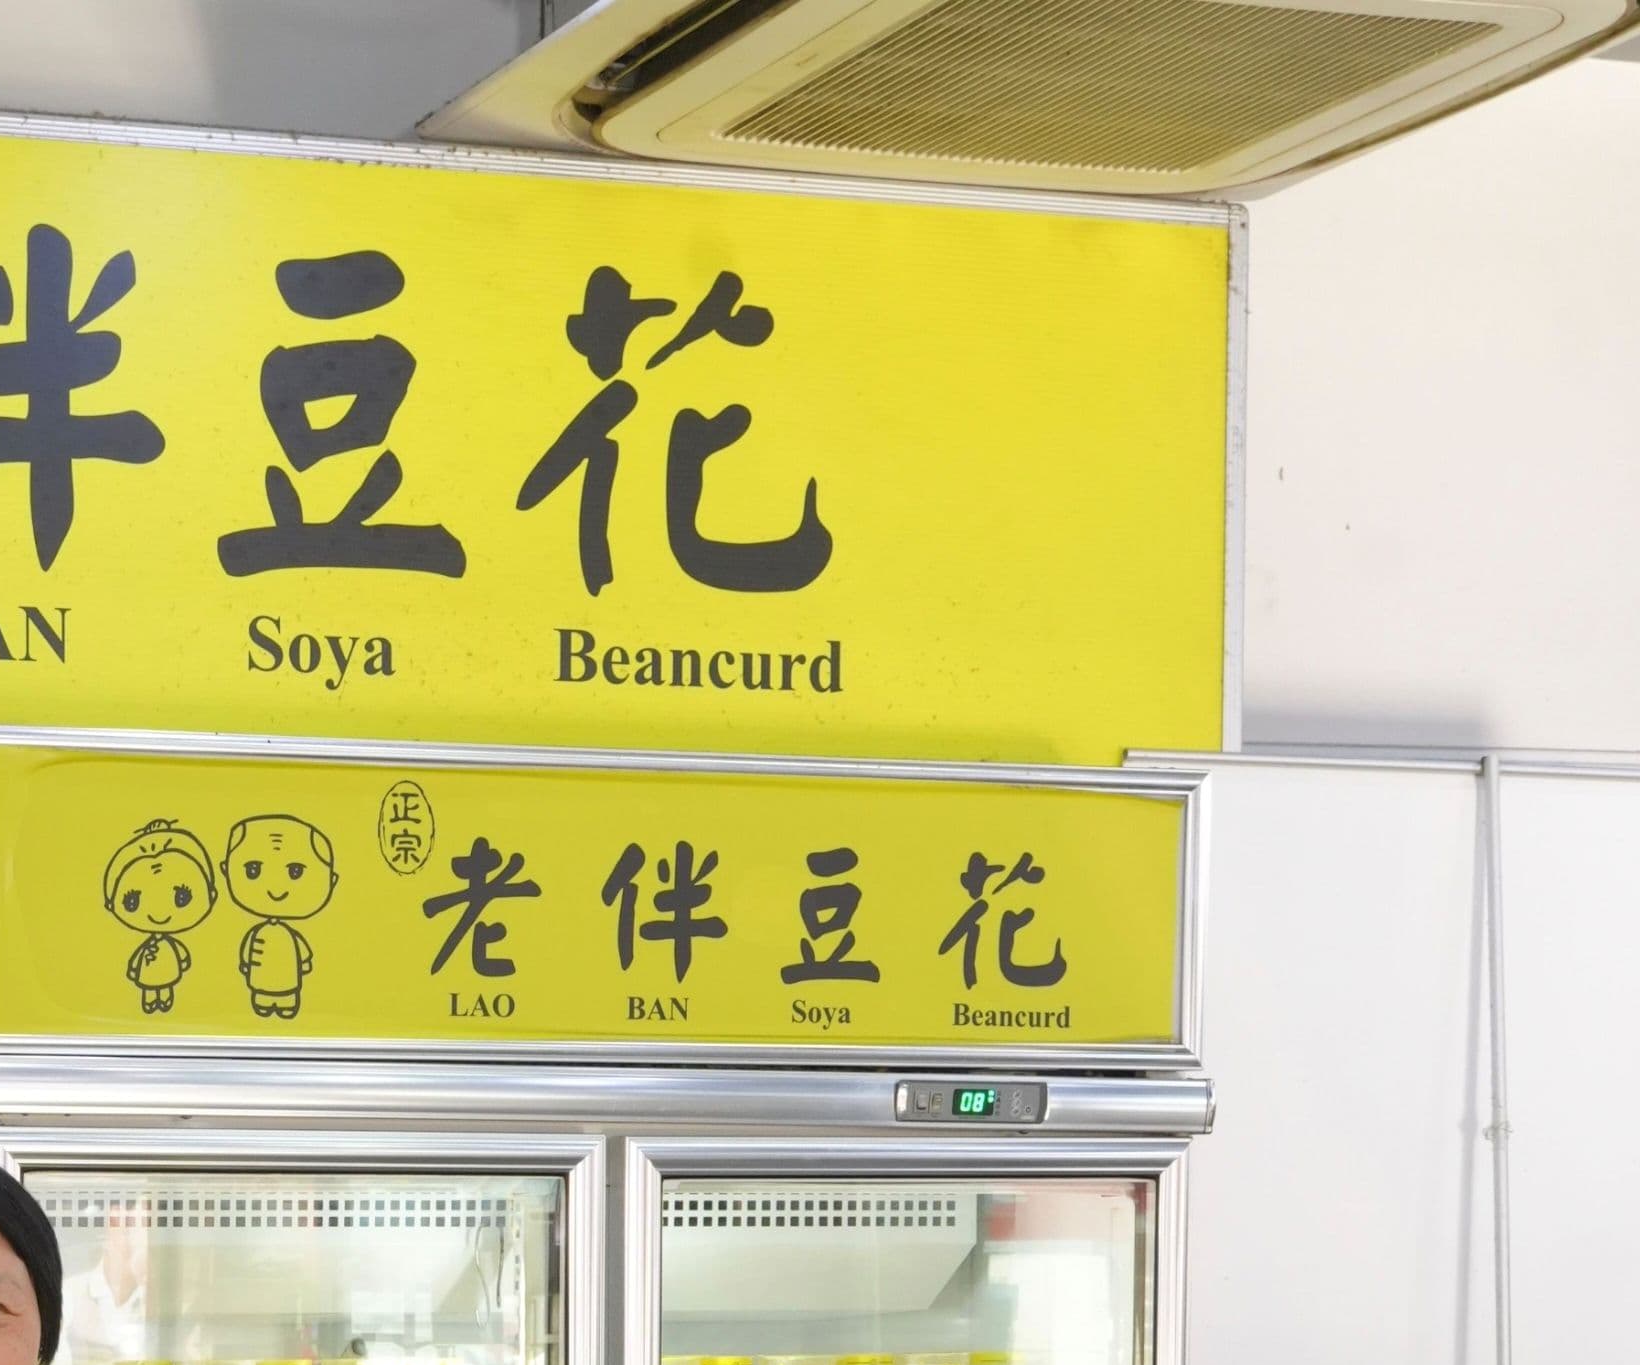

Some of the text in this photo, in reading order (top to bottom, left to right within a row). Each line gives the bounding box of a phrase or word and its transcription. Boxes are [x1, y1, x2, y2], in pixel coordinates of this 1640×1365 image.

[245, 615, 398, 685] Soya
[554, 628, 845, 696] Beancurd
[391, 793, 422, 865] 正宗
[422, 836, 1067, 990] 老伴豆花
[449, 993, 1071, 1030] LAO BAN Soya Beancurd
